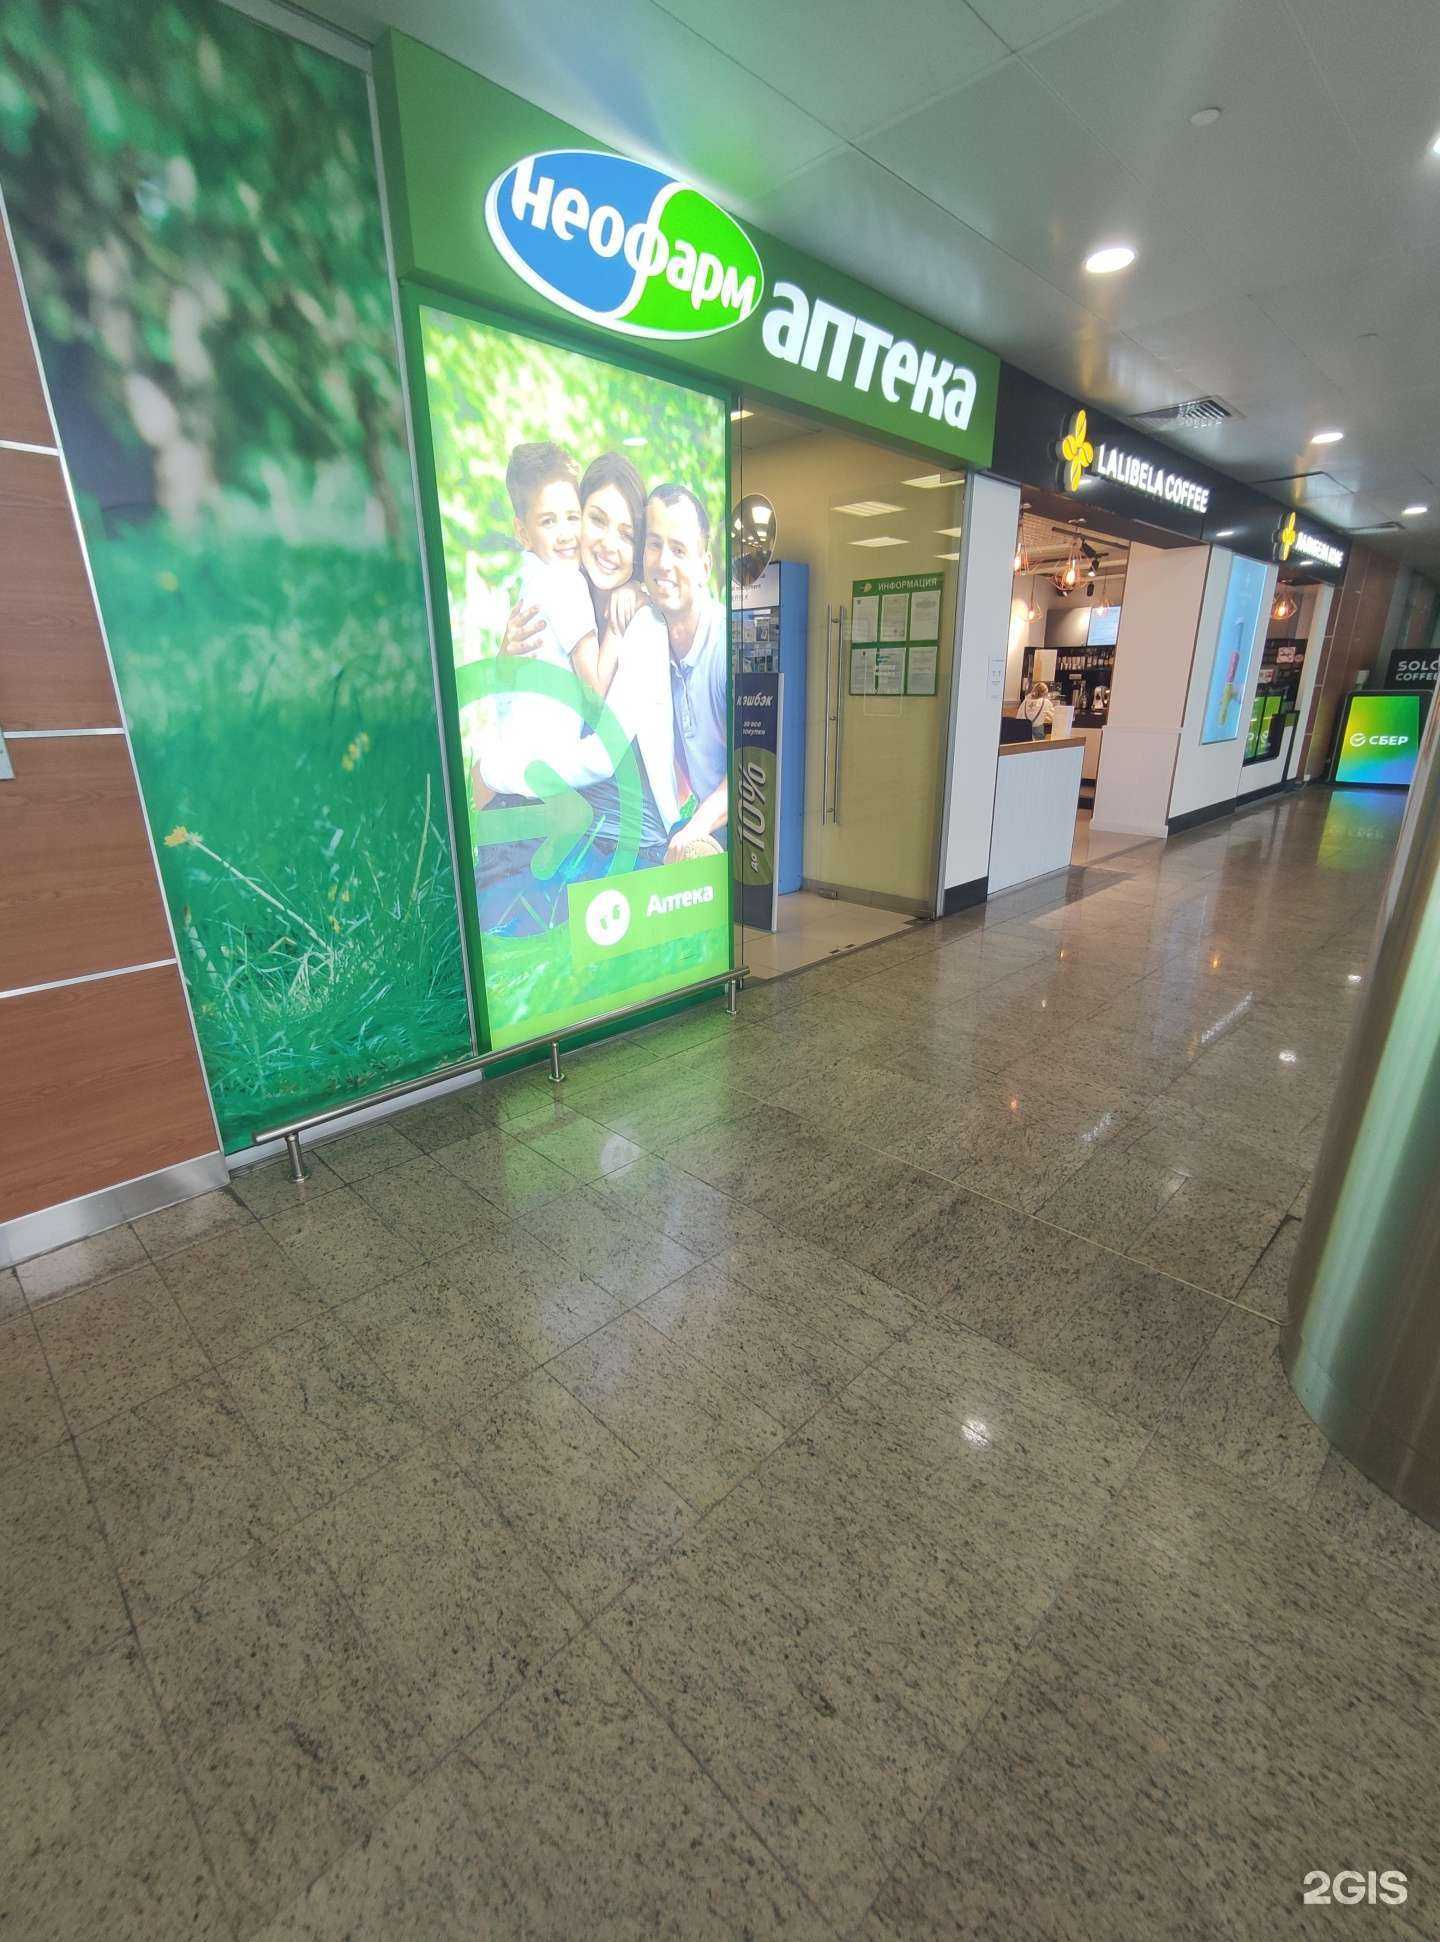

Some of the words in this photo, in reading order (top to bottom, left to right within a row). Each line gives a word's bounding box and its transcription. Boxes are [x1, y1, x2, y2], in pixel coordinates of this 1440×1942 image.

[761, 281, 978, 432] аптека
[1098, 443, 1165, 498] LALIBELA
[1165, 473, 1210, 514] COFFEE
[878, 577, 937, 592] ИНФОРМАЦИЯ
[1369, 735, 1409, 746] СБЕР
[738, 762, 766, 850] 10%
[645, 886, 714, 917] Аптека
